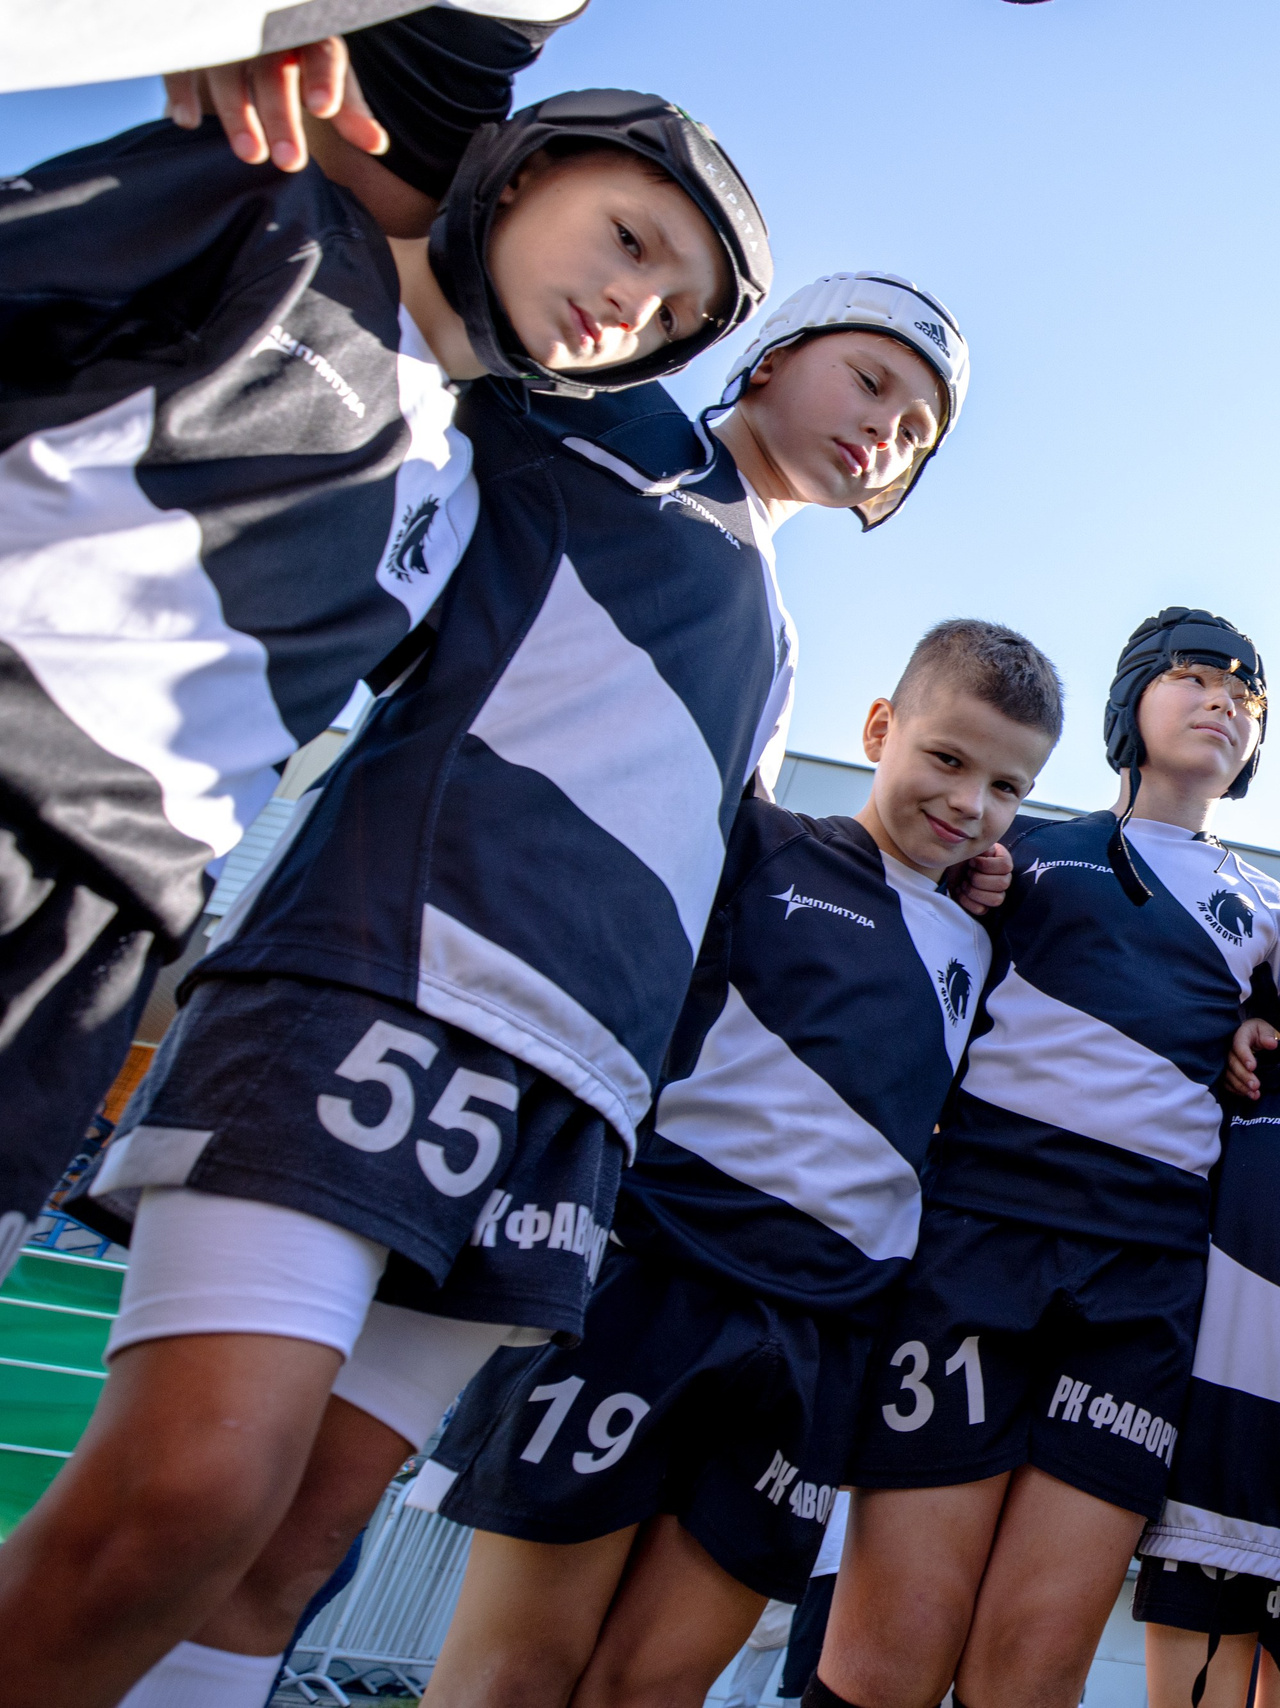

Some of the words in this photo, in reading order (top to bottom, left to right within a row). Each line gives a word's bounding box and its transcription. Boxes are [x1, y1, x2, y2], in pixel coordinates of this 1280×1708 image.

[914, 321, 951, 359] adidas
[1038, 860, 1115, 874] АМПЛИТУДА
[791, 894, 876, 929] АМПЛИТУДА
[1204, 914, 1243, 948] ФАВОРИТ
[316, 1018, 520, 1198] 55
[882, 1335, 986, 1433] 31
[1047, 1374, 1093, 1423] РК
[519, 1375, 651, 1475] 19
[753, 1449, 800, 1506] РК
